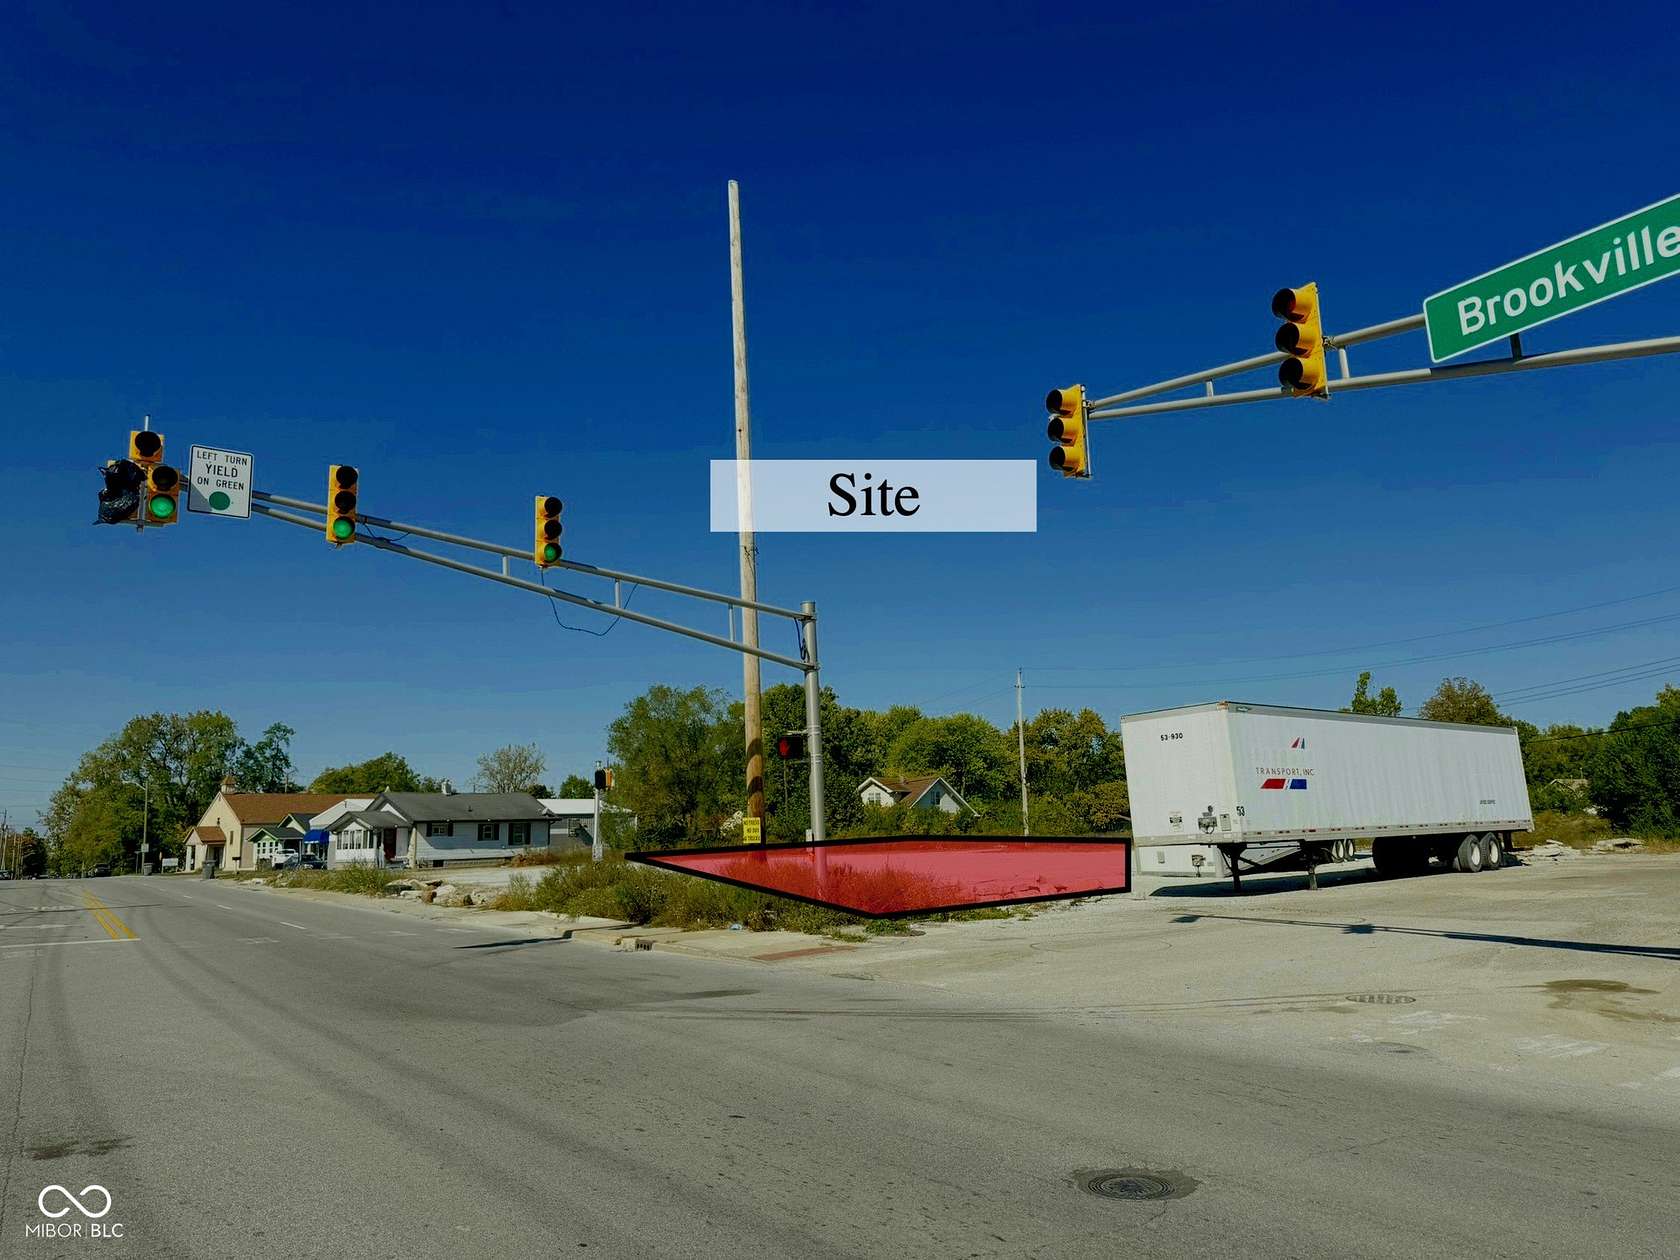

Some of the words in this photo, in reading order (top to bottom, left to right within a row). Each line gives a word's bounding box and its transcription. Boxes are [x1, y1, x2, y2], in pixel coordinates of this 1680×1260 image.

[1457, 225, 1680, 336] Brookville
[196, 450, 218, 461] LEFT
[225, 455, 247, 466] TURN
[206, 463, 238, 478] YIELD
[197, 476, 209, 486] ON
[216, 479, 244, 491] GREEN
[1236, 805, 1245, 817] 53
